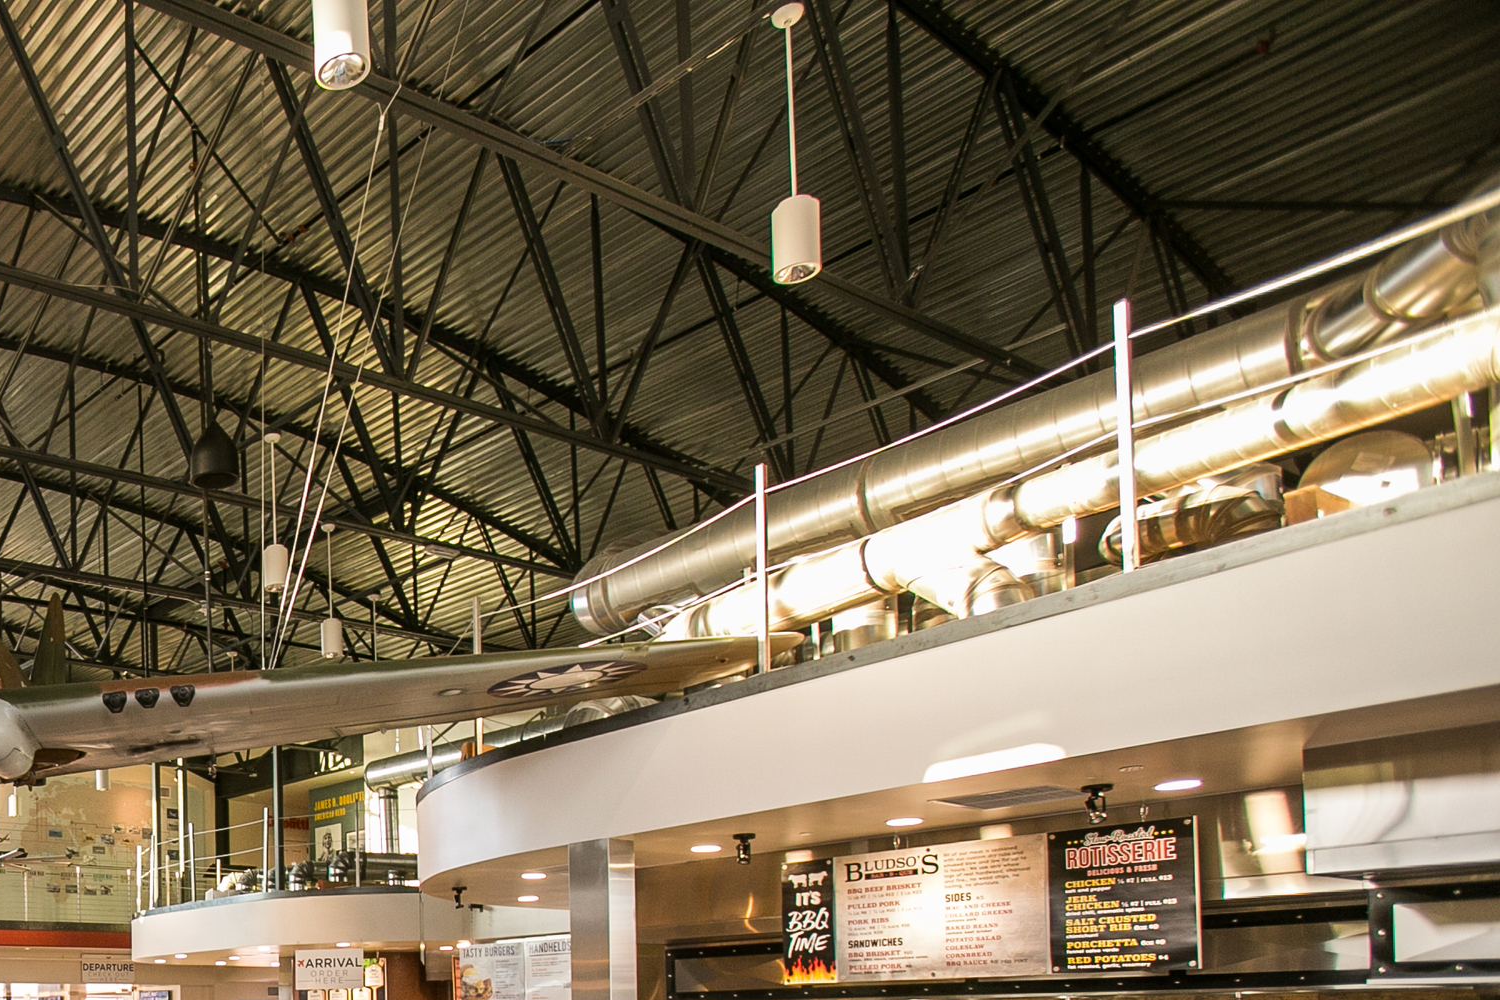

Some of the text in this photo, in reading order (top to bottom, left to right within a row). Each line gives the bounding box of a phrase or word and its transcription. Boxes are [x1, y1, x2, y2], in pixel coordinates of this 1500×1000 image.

[339, 791, 365, 806] DOOLITTL
[1065, 837, 1177, 870] ROTISSERIE
[844, 853, 939, 882] BLUDSO'S
[1087, 866, 1124, 876] DELICIOUS
[1134, 864, 1158, 872] FRESH
[886, 882, 922, 891] BRISKET
[1065, 877, 1116, 888] CHICKEN
[795, 890, 821, 907] IT'S
[945, 892, 971, 902] SIDES
[1065, 895, 1098, 904] JERK
[847, 900, 900, 910] PULLED PORK
[1065, 900, 1120, 911] CHICKEN
[786, 907, 829, 932] BBQ
[1065, 913, 1157, 926] SALT CRUSTED
[1065, 924, 1106, 934] SHORT
[1109, 923, 1132, 932] RIB
[529, 941, 571, 953] HANDHELDS
[788, 931, 831, 959] TIME
[848, 937, 903, 949] SANDWICHES
[1066, 938, 1138, 949] PORCHETTA
[463, 945, 515, 959] TASTY BURGERS
[305, 957, 362, 968] ARRIVAL
[1067, 956, 1092, 964] RED
[1094, 953, 1157, 963] POTATOES
[82, 963, 134, 971] DEPARTURE
